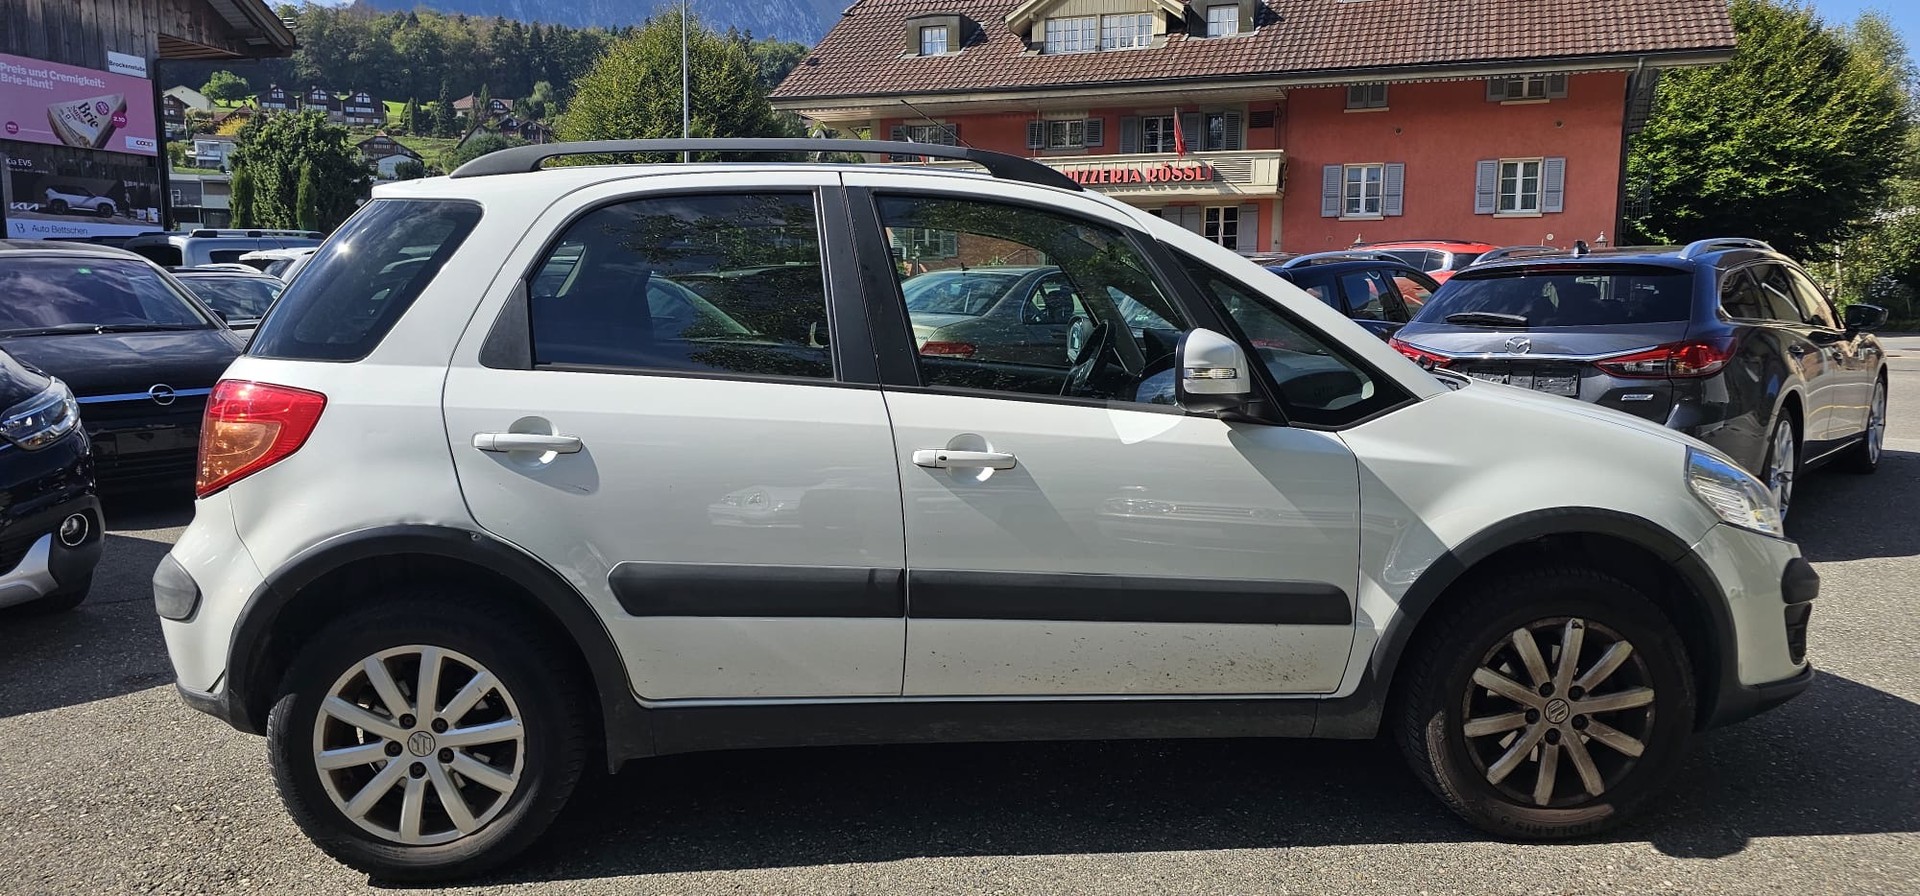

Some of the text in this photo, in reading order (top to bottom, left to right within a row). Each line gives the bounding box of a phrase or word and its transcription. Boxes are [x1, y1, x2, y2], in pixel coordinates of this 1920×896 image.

[109, 60, 146, 71] Brockenstube
[0, 62, 105, 88] Preis und Cremigkeit:
[78, 102, 98, 128] Brie
[18, 159, 32, 167] EV5
[10, 201, 39, 210] KIA
[32, 224, 88, 235] Auto Bettschen
